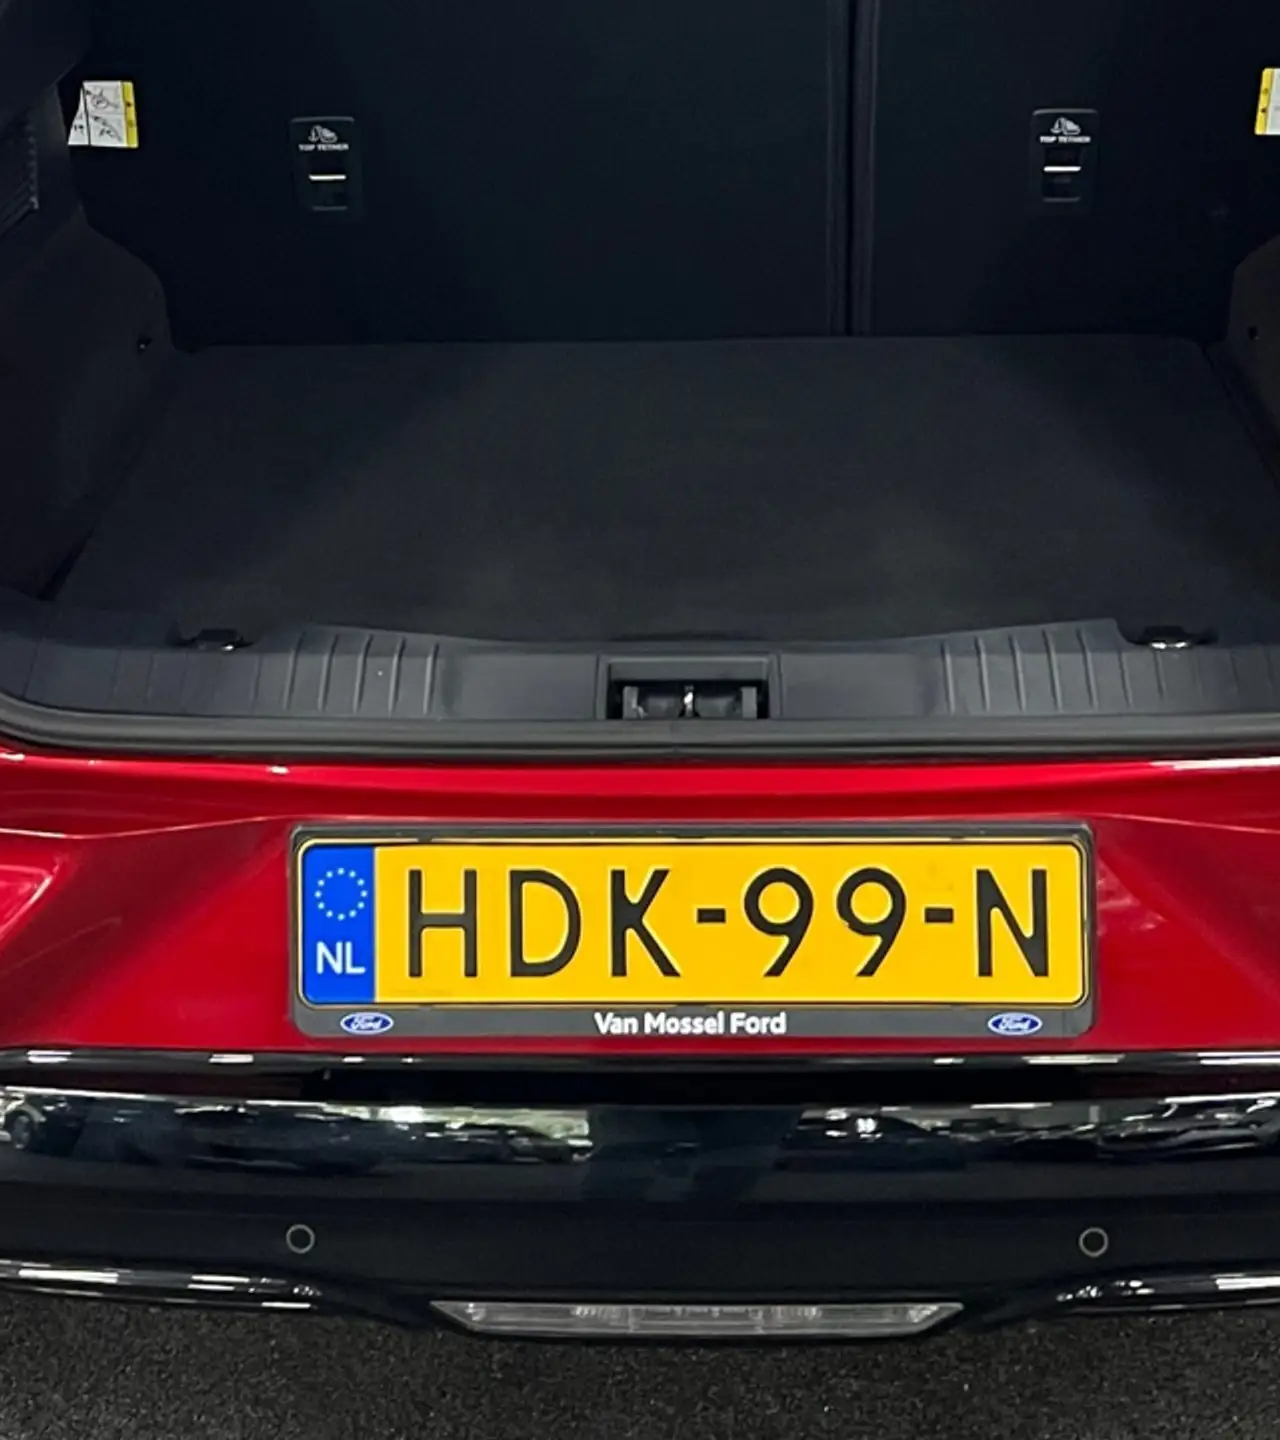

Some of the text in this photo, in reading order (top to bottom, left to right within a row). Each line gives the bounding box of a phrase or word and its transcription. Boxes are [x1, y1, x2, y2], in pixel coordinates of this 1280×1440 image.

[408, 867, 1049, 978] HDK-99-N
[315, 940, 367, 975] NL
[593, 1010, 787, 1035] Van Mossel Ford
